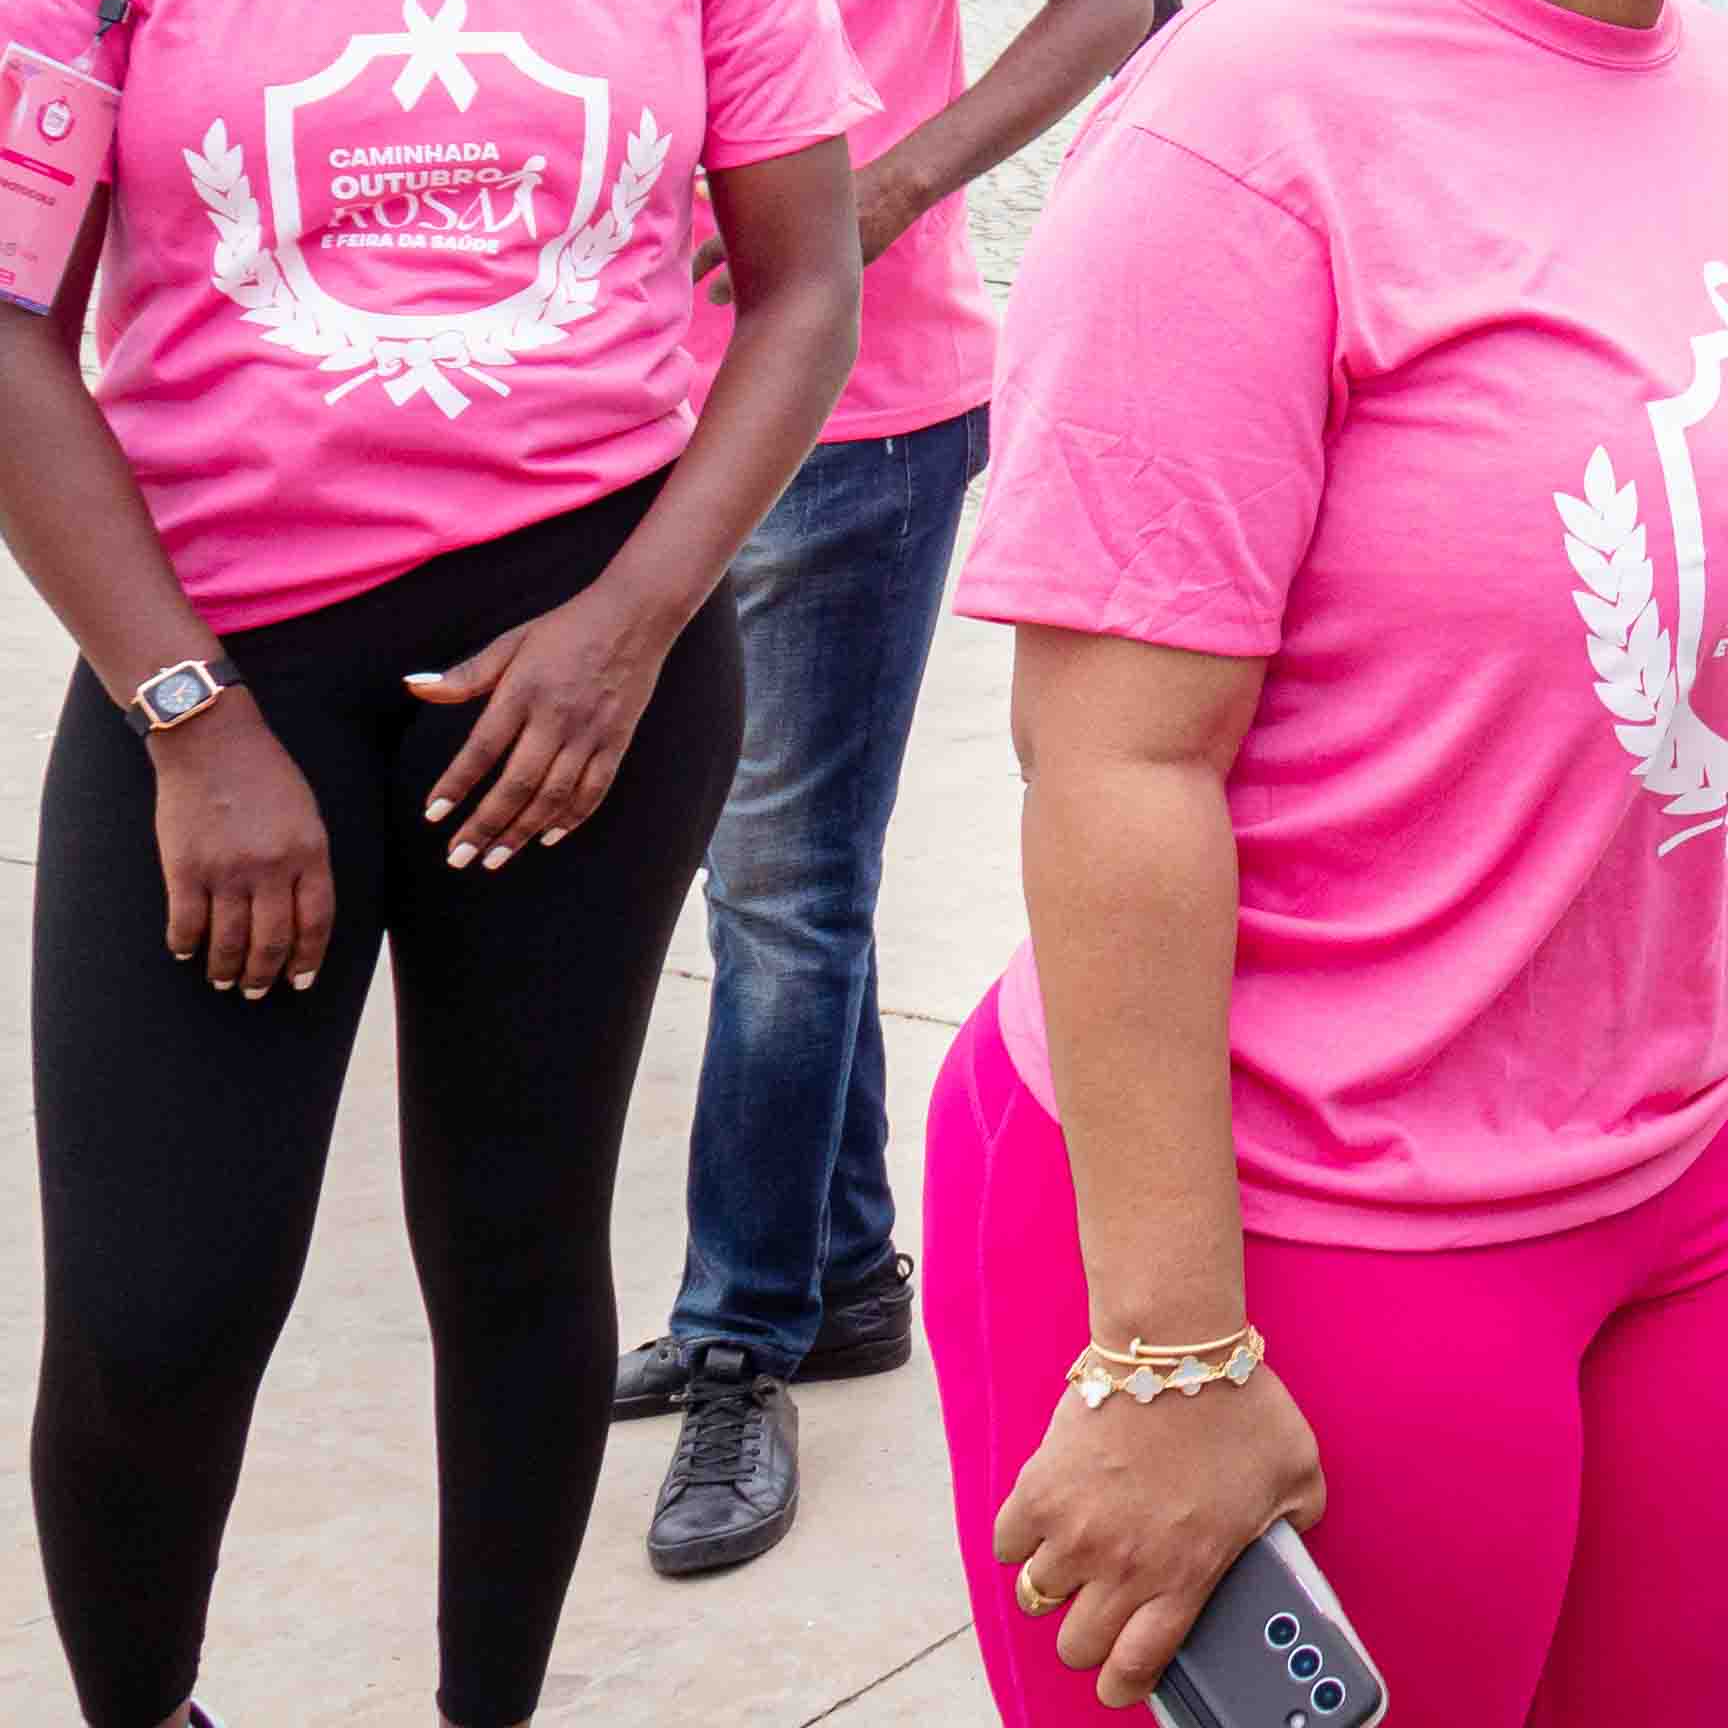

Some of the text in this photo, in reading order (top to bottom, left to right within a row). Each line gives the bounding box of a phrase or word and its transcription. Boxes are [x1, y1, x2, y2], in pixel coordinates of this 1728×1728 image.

[329, 141, 500, 169] CAMINHADA
[330, 167, 503, 200] OUTUBRO
[336, 232, 395, 249] FEIRA
[397, 233, 428, 248] DA
[430, 232, 500, 254] SAÚDE
